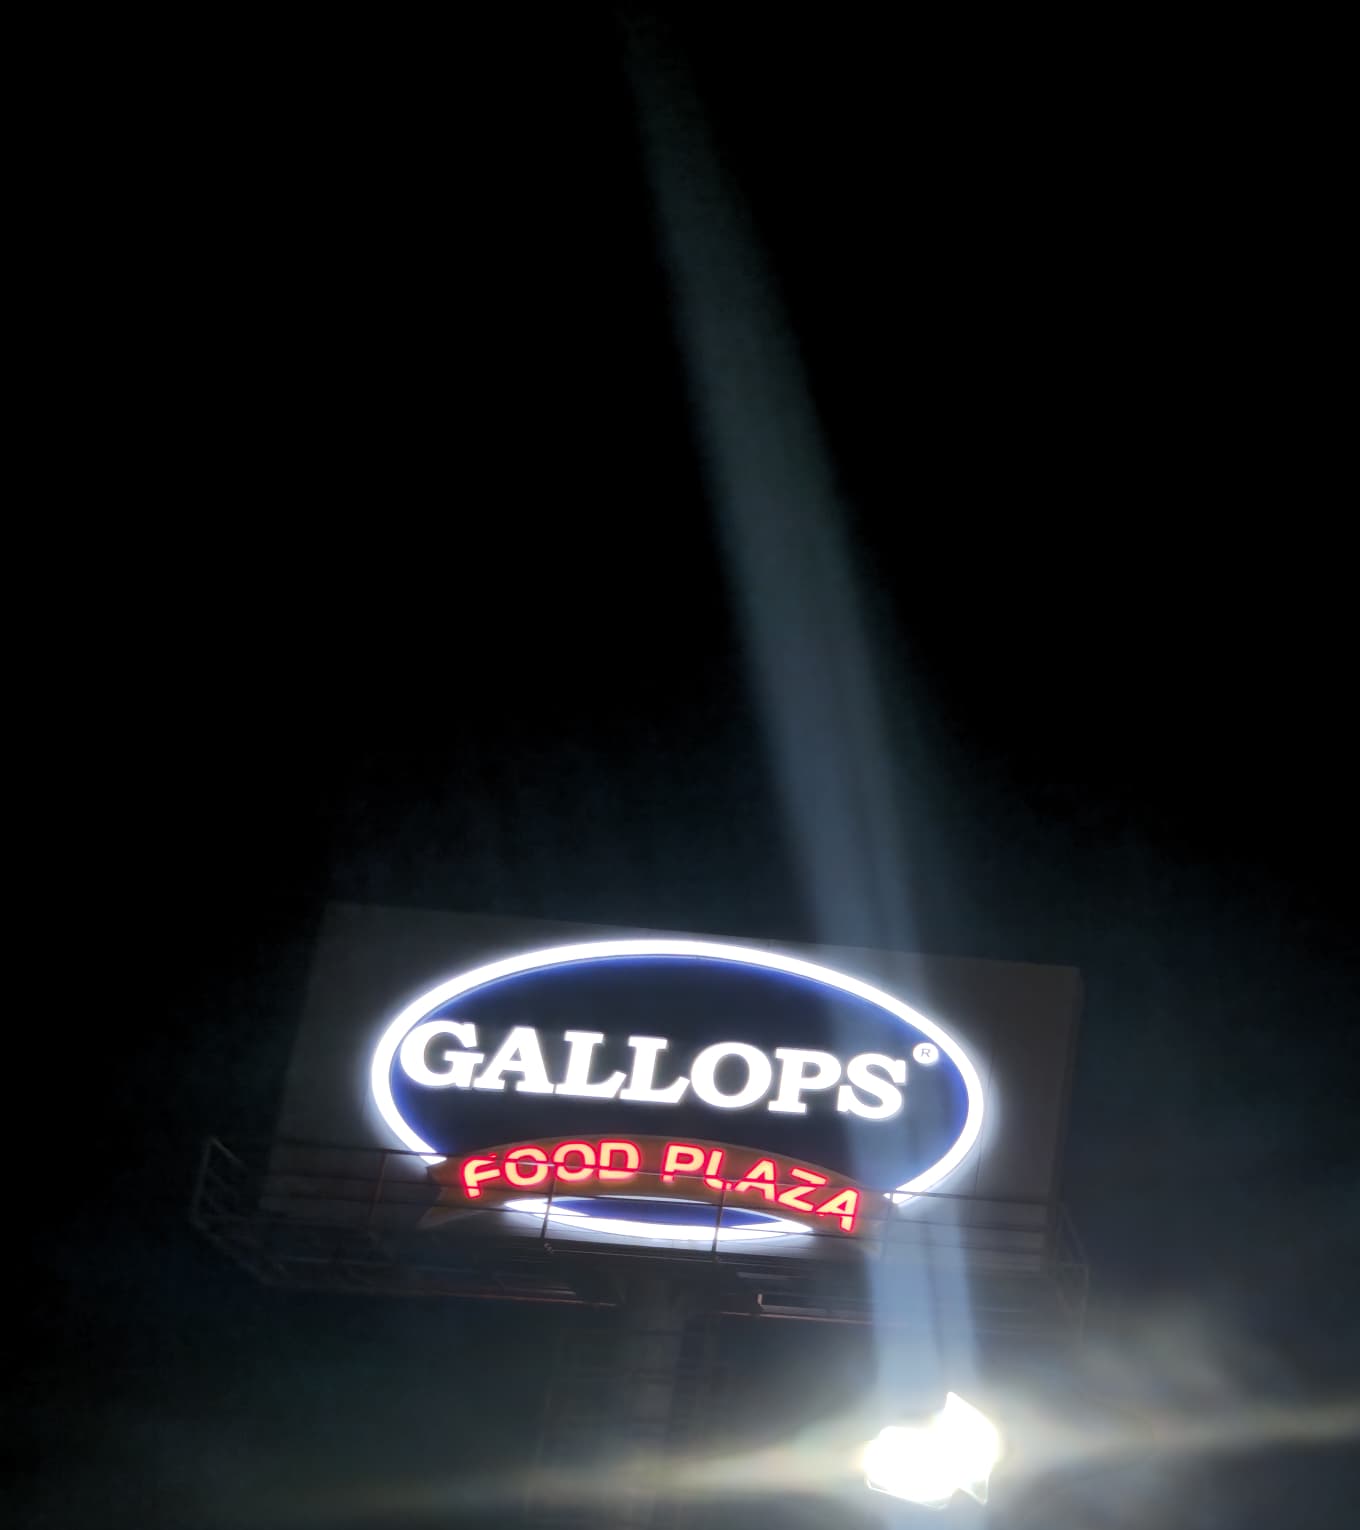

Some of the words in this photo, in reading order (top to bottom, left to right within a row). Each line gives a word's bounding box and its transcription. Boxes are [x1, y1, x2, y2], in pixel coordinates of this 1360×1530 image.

[400, 1020, 907, 1121] GALLOPS
[461, 1139, 643, 1200] FOOD
[662, 1143, 860, 1235] PLAZA
